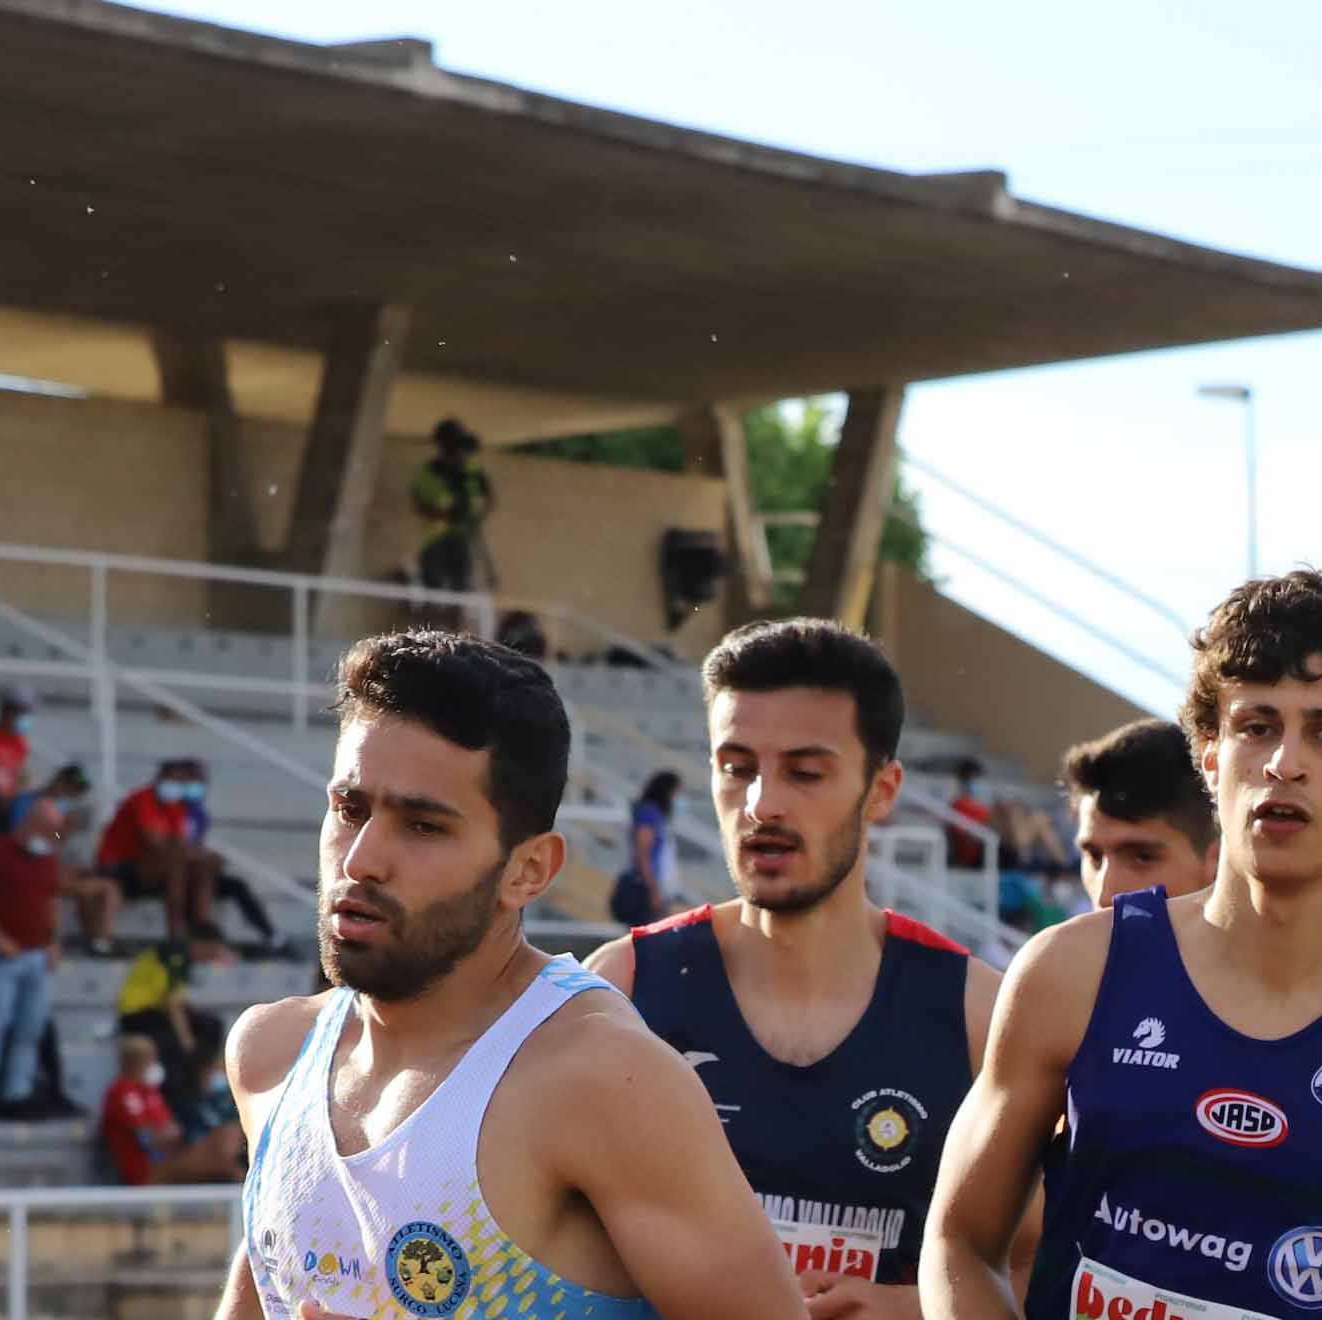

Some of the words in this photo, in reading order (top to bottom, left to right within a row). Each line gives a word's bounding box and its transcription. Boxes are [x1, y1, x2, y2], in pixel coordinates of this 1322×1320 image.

[1112, 1048, 1180, 1069] VIATOR
[1211, 1103, 1276, 1133] JASO
[386, 1223, 463, 1260] ATLETISMO
[1094, 1191, 1254, 1272] Autowag
